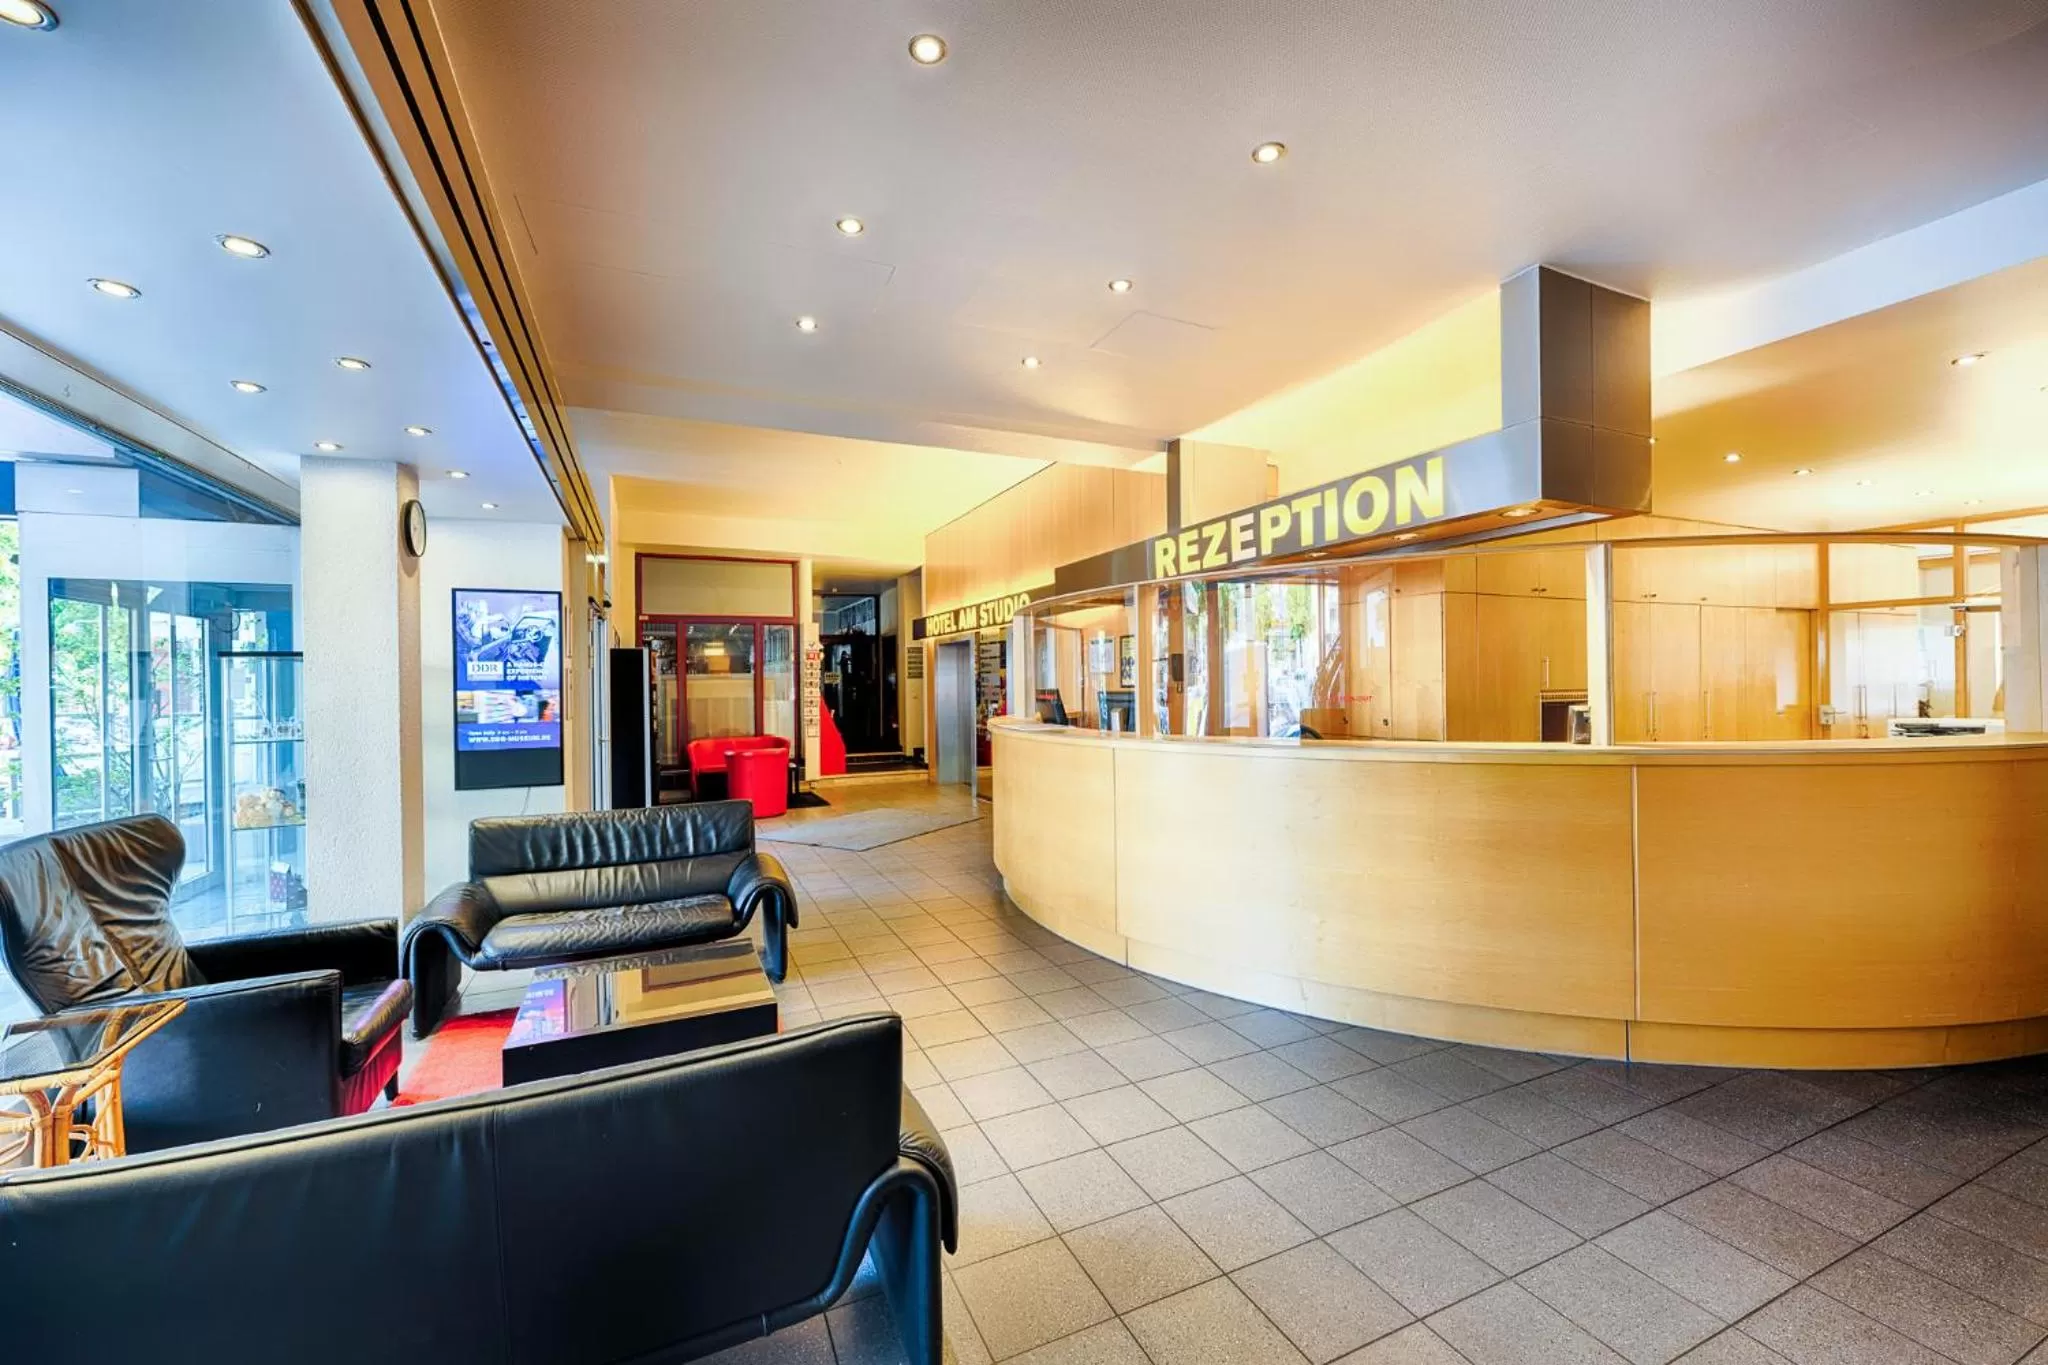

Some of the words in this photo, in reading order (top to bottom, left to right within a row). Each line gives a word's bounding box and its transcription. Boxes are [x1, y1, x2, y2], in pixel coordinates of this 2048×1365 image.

[1155, 456, 1444, 579] REZEPTION
[926, 611, 957, 637] HOTEL
[959, 606, 978, 631] AM
[980, 593, 1031, 627] STUDIO
[471, 664, 499, 673] DDR
